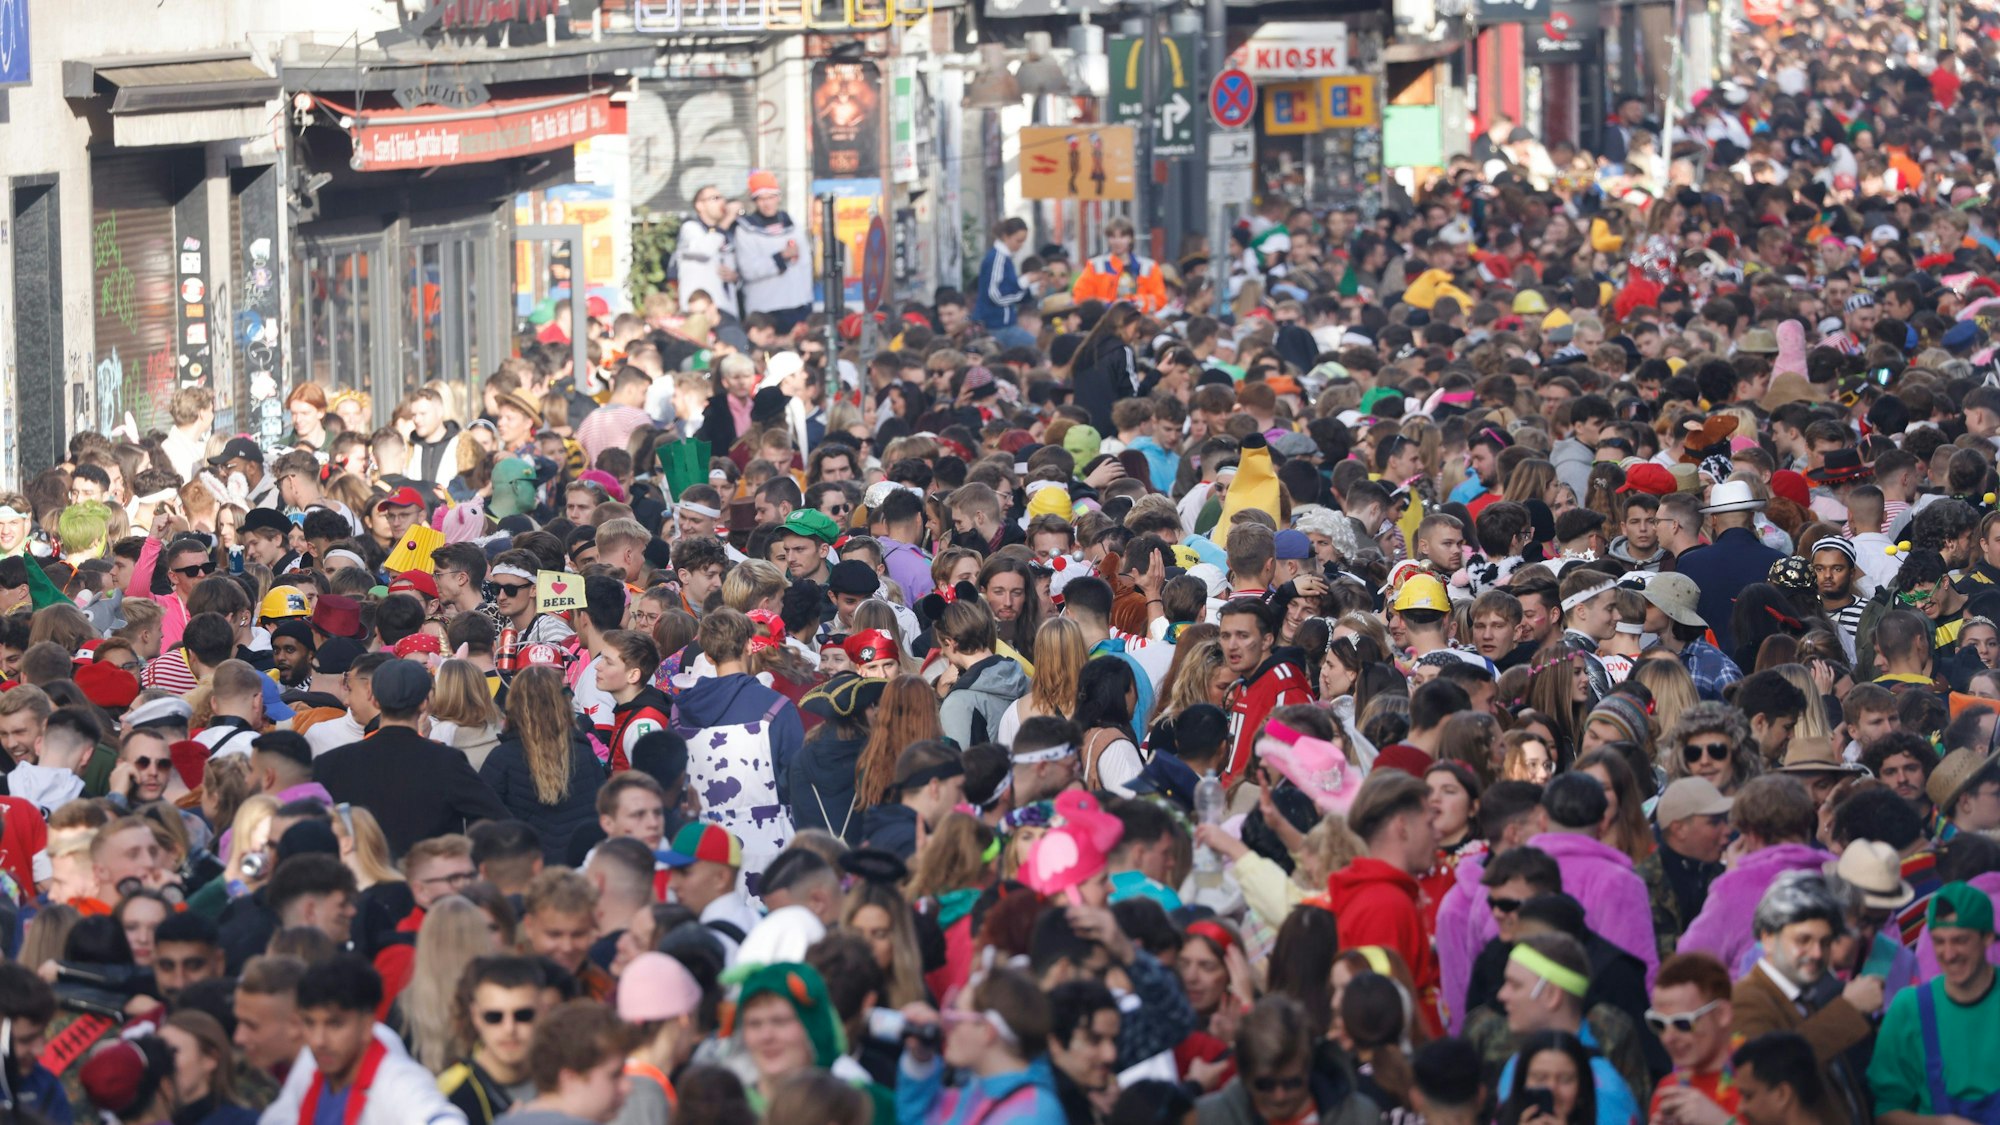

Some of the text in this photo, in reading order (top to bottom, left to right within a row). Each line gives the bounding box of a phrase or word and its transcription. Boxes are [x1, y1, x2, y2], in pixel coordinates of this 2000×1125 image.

[1256, 48, 1335, 69] KIOSK
[404, 84, 478, 104] PAPELITO
[543, 597, 576, 607] BEER
